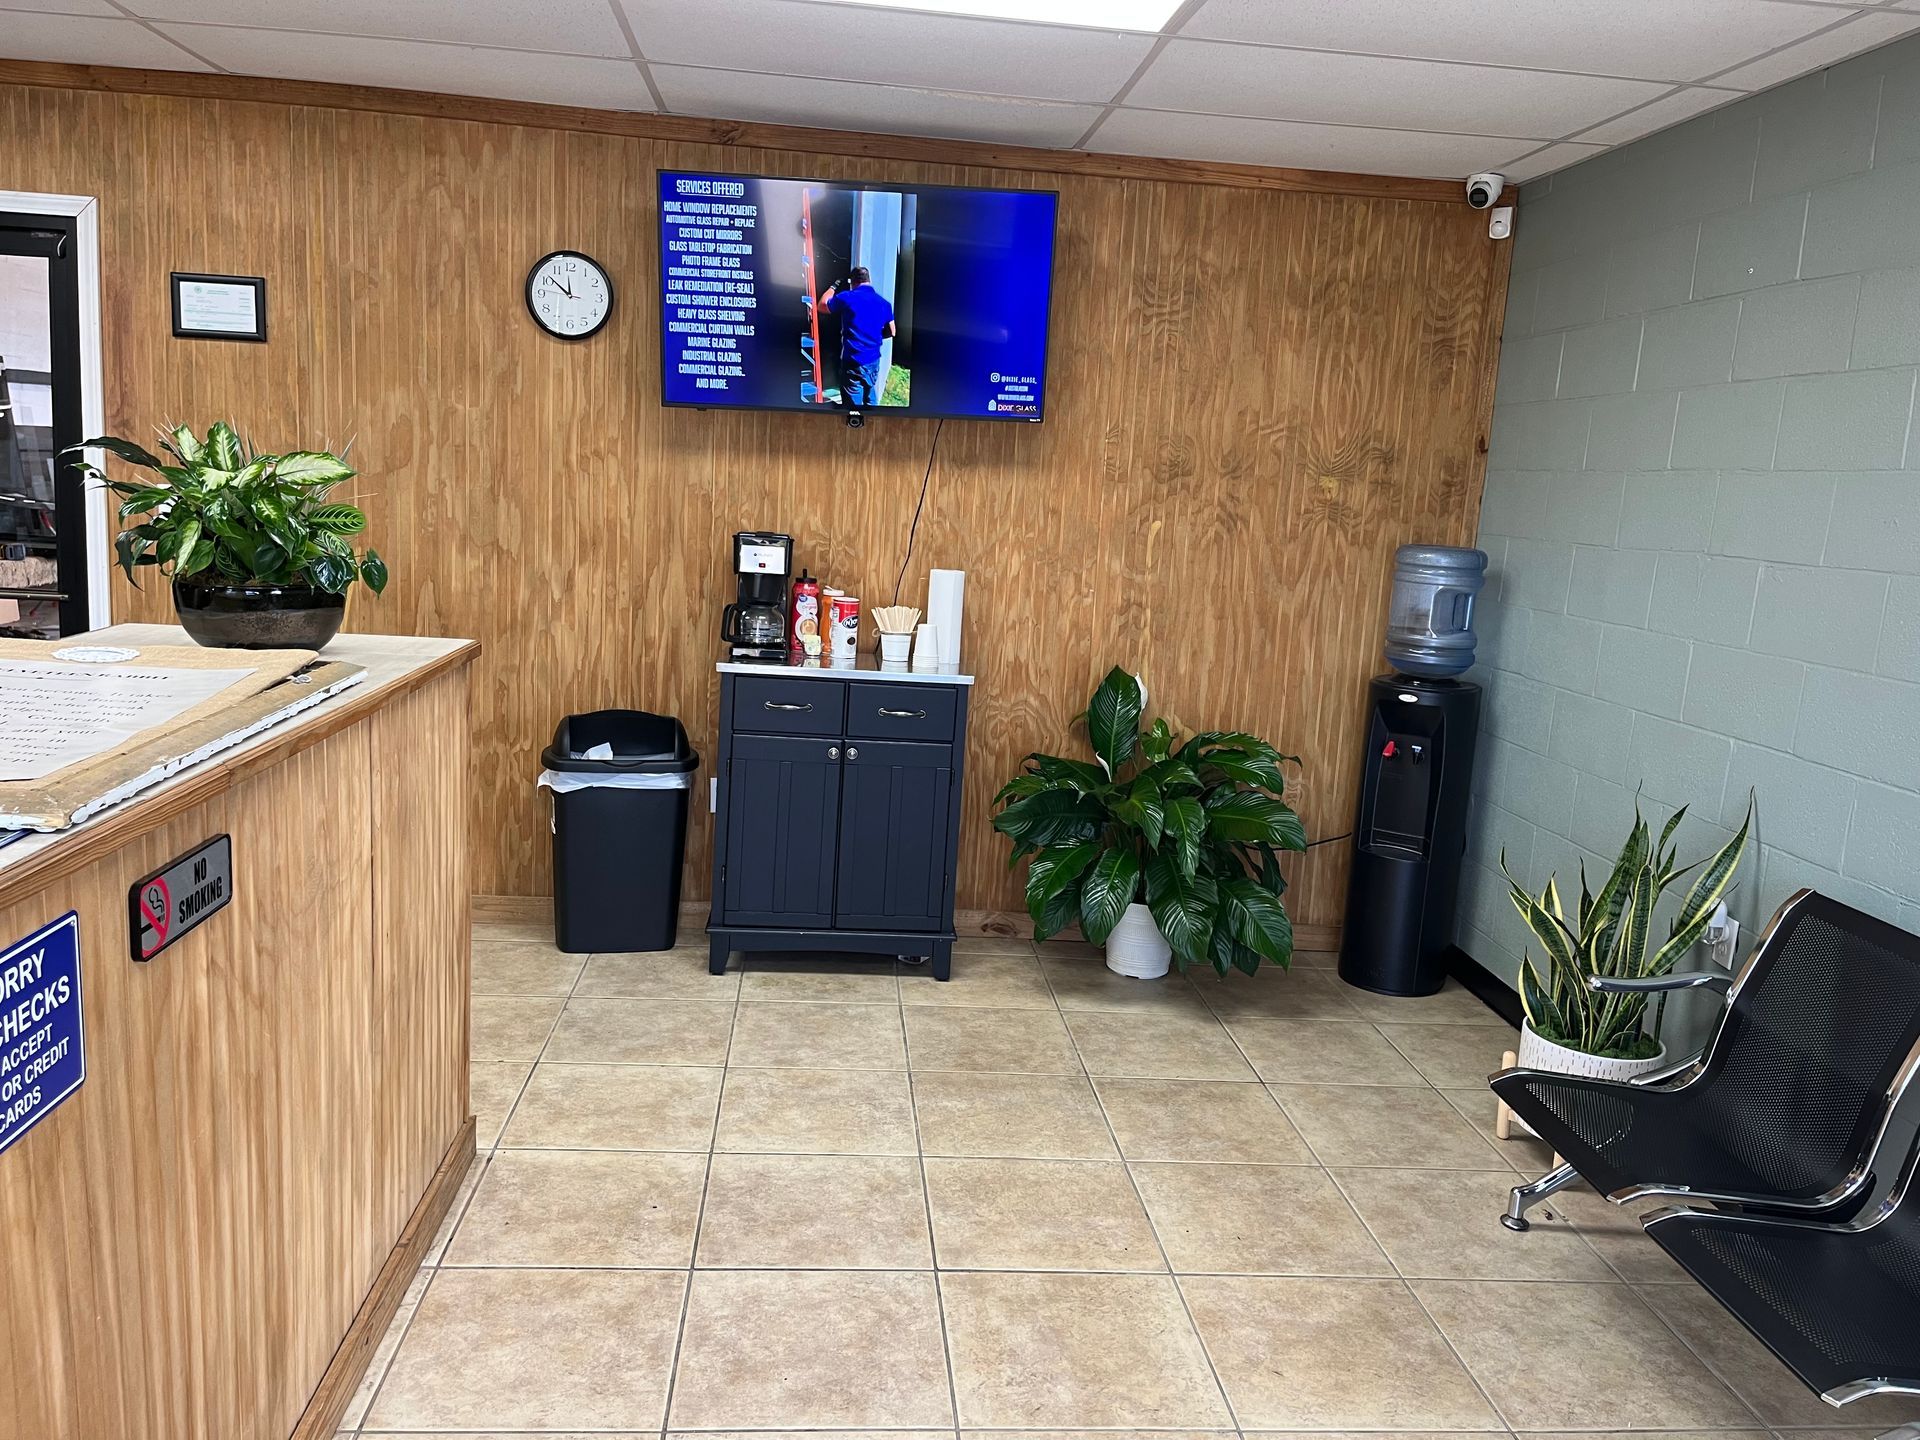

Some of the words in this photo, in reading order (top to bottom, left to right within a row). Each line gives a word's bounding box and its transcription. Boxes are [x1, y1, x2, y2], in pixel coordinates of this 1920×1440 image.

[676, 179, 710, 194] SERVICES
[712, 182, 744, 196] OFFERED
[664, 201, 681, 212] HOME
[683, 202, 710, 214] WINDOW
[712, 203, 757, 216] REPLACEMENTS
[666, 214, 696, 225] AUTOMOTIVE
[697, 216, 711, 225] GLASS
[712, 217, 729, 226] REPAIR
[734, 218, 755, 228] REPLACE
[679, 227, 702, 239] CUSTOM
[704, 228, 715, 239] CUT
[716, 229, 742, 240] MIRRORS
[669, 240, 687, 251] GLASS
[688, 241, 715, 253] TABLETOP
[717, 243, 752, 255] FABRICATION
[565, 262, 576, 272] 12
[682, 255, 700, 266] PHOTO
[702, 256, 721, 267] FRAME
[722, 257, 740, 268] GLASS
[553, 265, 560, 275] 11
[669, 267, 700, 277] COMMERCIAL
[701, 269, 731, 279] STOREFRONT
[542, 276, 554, 286] 10
[591, 278, 599, 288] 2
[668, 279, 683, 290] LEAK
[684, 280, 723, 292] REMEDIATION
[725, 282, 754, 294] (RE-SEAL)
[537, 289, 546, 298] 9
[595, 293, 603, 303] 3
[666, 293, 691, 305] CUSTOM
[692, 295, 718, 306] SHOWER
[720, 296, 756, 308] ENCLOSURES
[542, 303, 550, 313] 8
[591, 308, 598, 317] 4
[678, 308, 697, 319] HEAVY
[698, 309, 716, 320] GLASS
[717, 310, 745, 321] SHELVING
[566, 320, 574, 329] 6
[580, 317, 588, 326] 5
[669, 322, 707, 333] COMMERCIAL
[708, 323, 733, 335] CURTAIN
[734, 325, 754, 336] WALLS
[687, 336, 710, 347] MARINE
[712, 337, 736, 349] GLAZING
[682, 350, 716, 361] INDUSTRIAL
[717, 351, 741, 362] GLAZING
[679, 363, 717, 375] COMMERCIAL
[696, 378, 708, 388] AND
[709, 378, 728, 389] MORE.
[194, 857, 207, 885] NO
[179, 876, 222, 924] SMOKING
[1, 1022, 53, 1077] ACCEPT
[2, 1073, 22, 1102] OR
[24, 1036, 70, 1085] CREDIT
